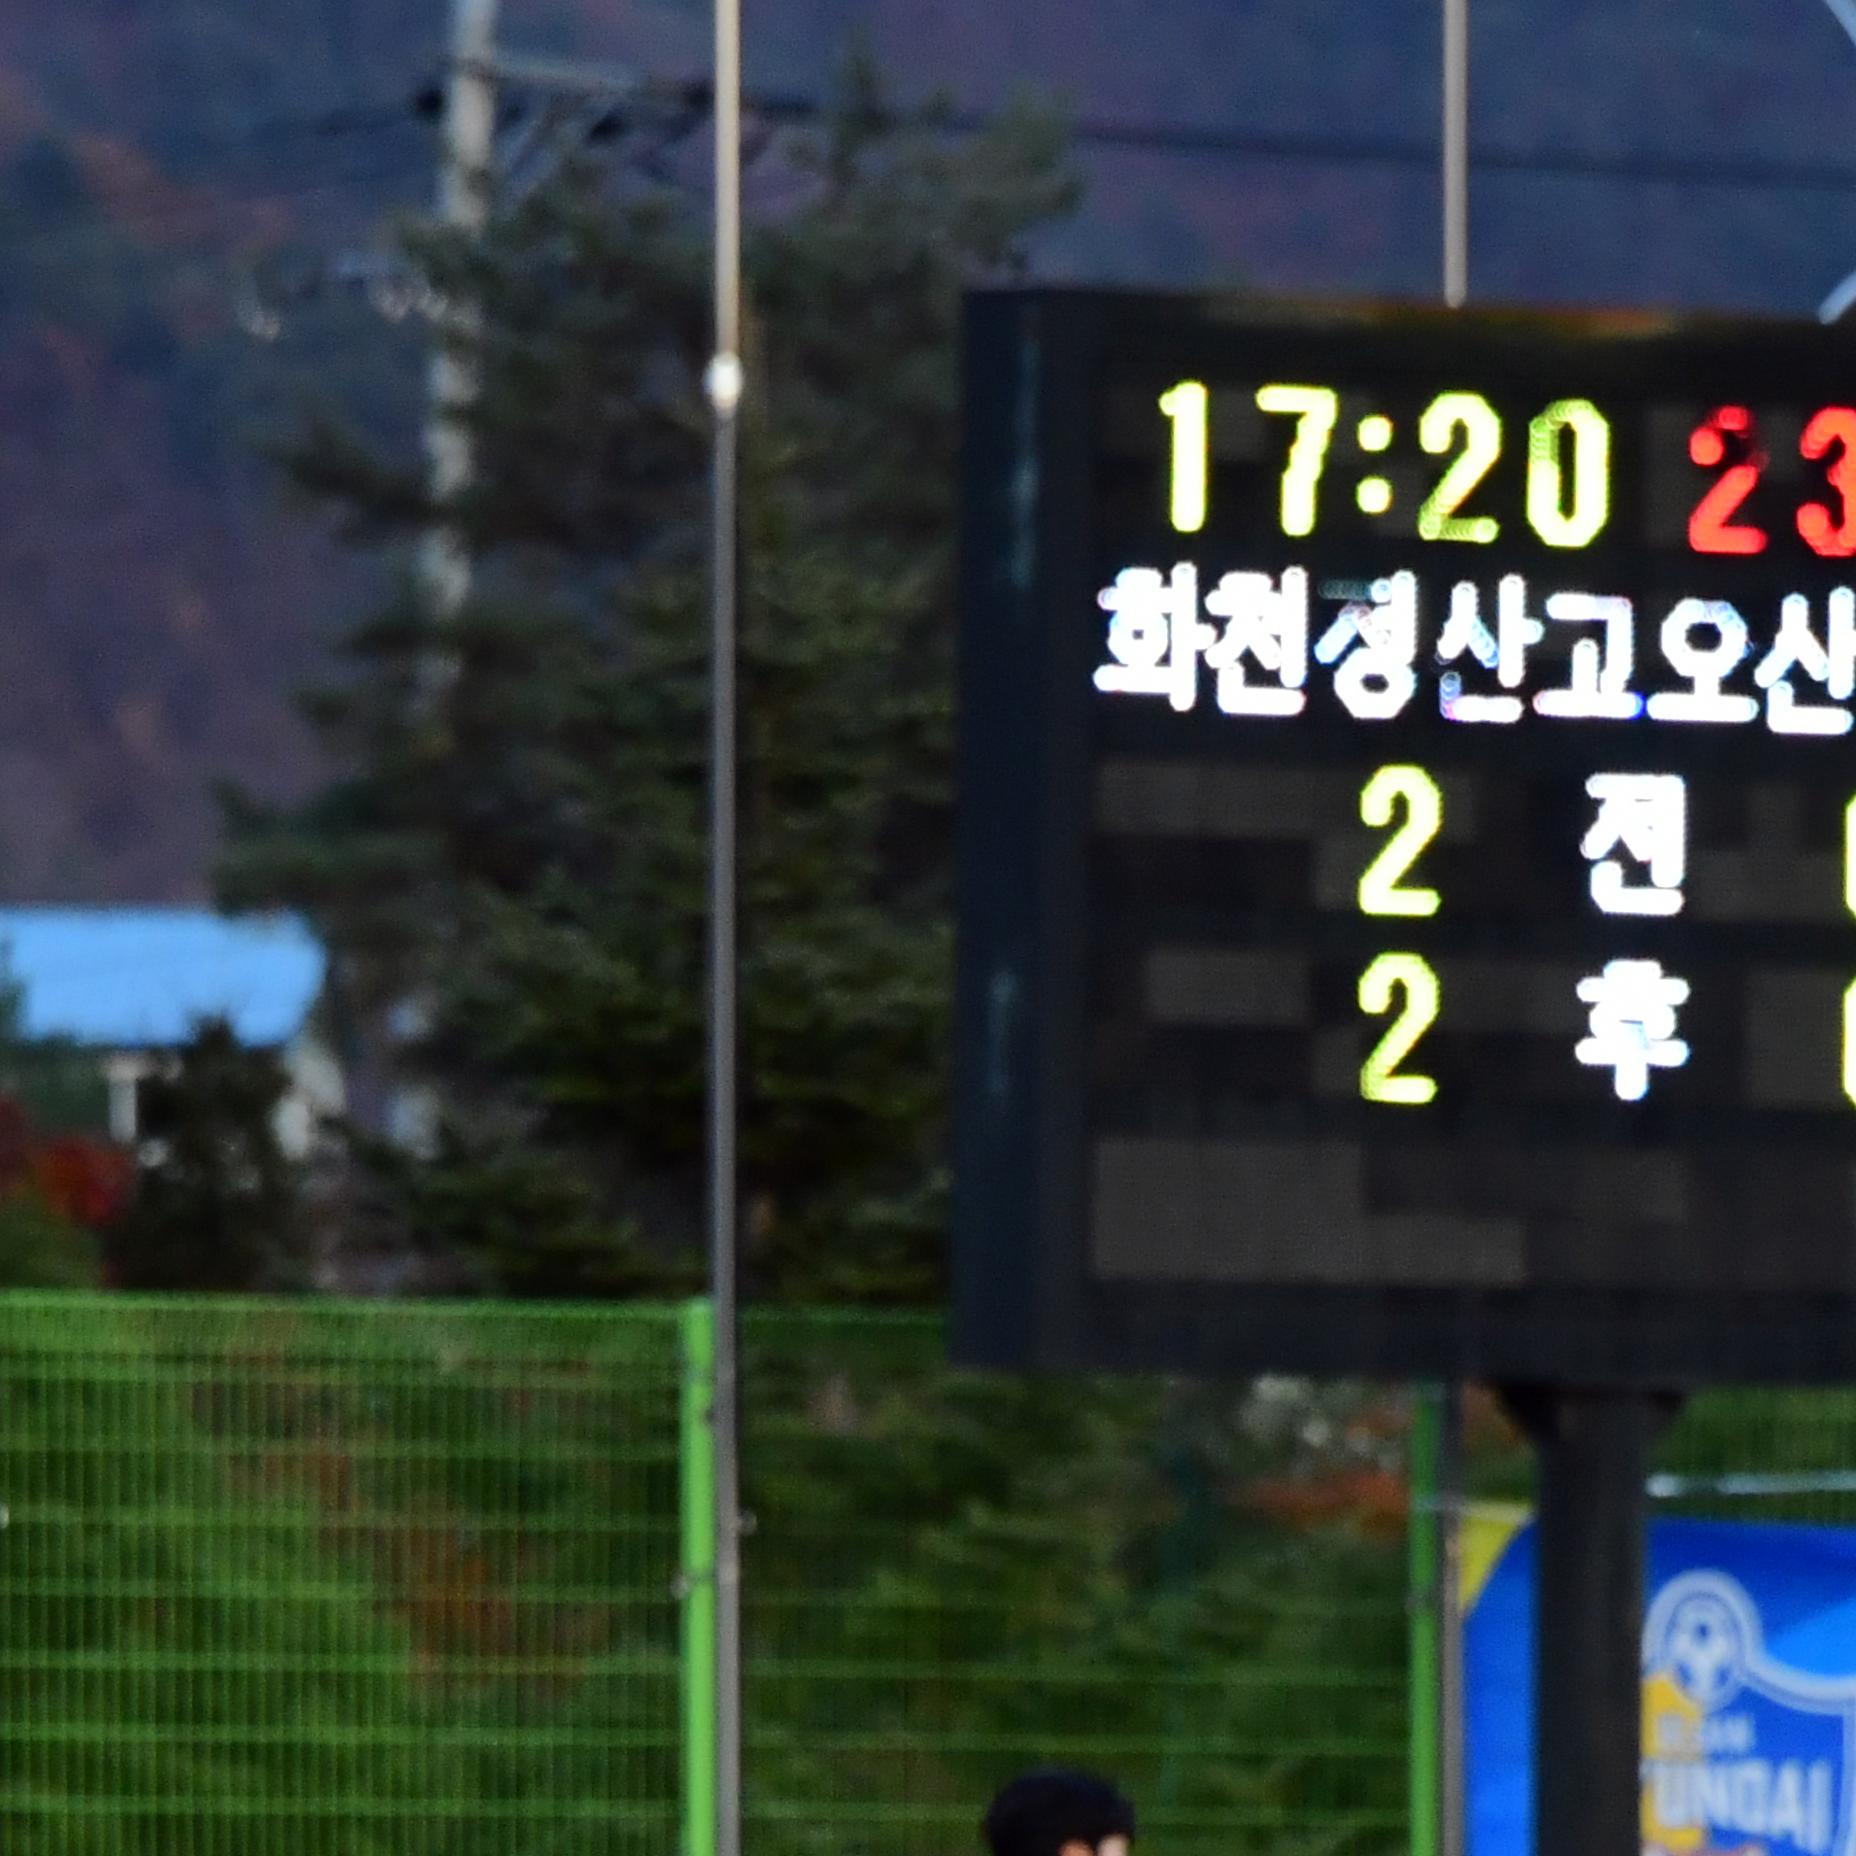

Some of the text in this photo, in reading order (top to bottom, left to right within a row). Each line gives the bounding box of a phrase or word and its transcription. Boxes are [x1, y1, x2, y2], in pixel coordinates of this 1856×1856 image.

[1158, 381, 1610, 547] 17:20
[1357, 765, 1443, 918] 2
[1580, 772, 1687, 916] 전
[1357, 952, 1441, 1104] 2
[1575, 959, 1690, 1101] 후
[1640, 1760, 1834, 1856] UNDAI
